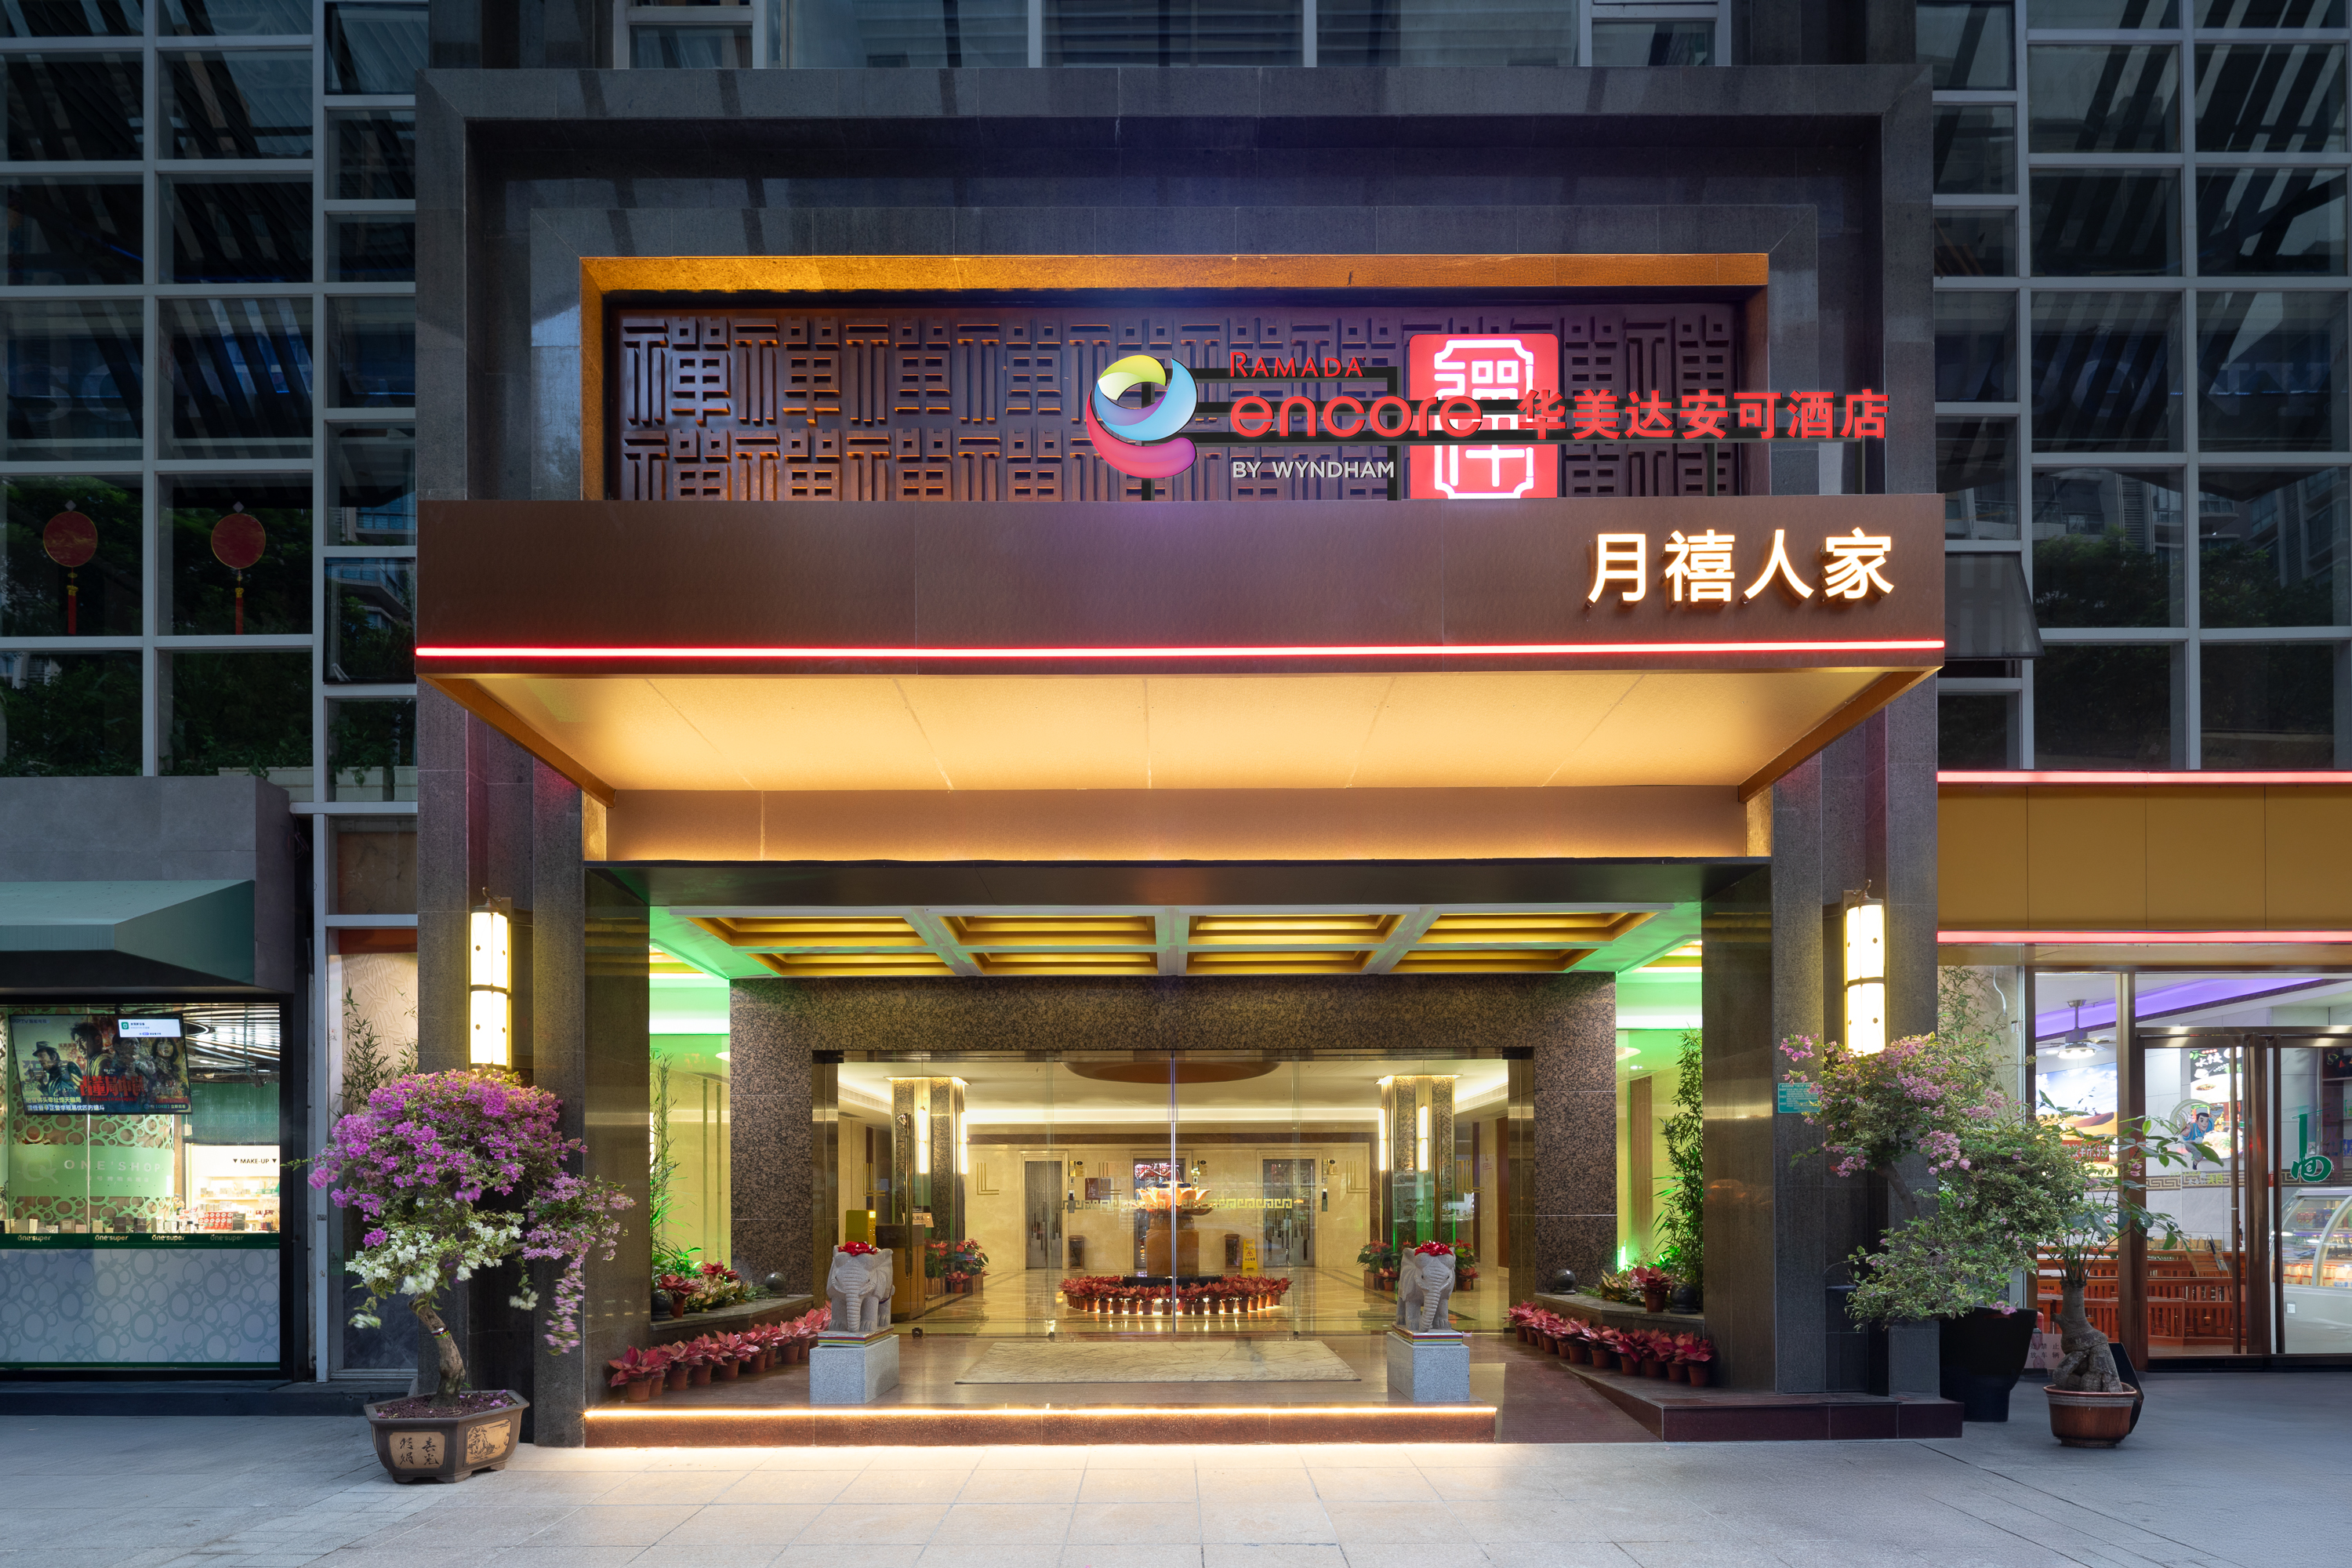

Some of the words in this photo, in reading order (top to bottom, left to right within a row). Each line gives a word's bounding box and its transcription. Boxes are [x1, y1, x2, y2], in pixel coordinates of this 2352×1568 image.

[1230, 352, 1364, 378] RAMADA
[1230, 395, 1483, 437] encore
[1516, 389, 1889, 440] 华美达安可酒店
[1232, 461, 1262, 478] BY
[1272, 461, 1396, 478] WYNDHAM
[1588, 527, 1895, 604] 月禧人家
